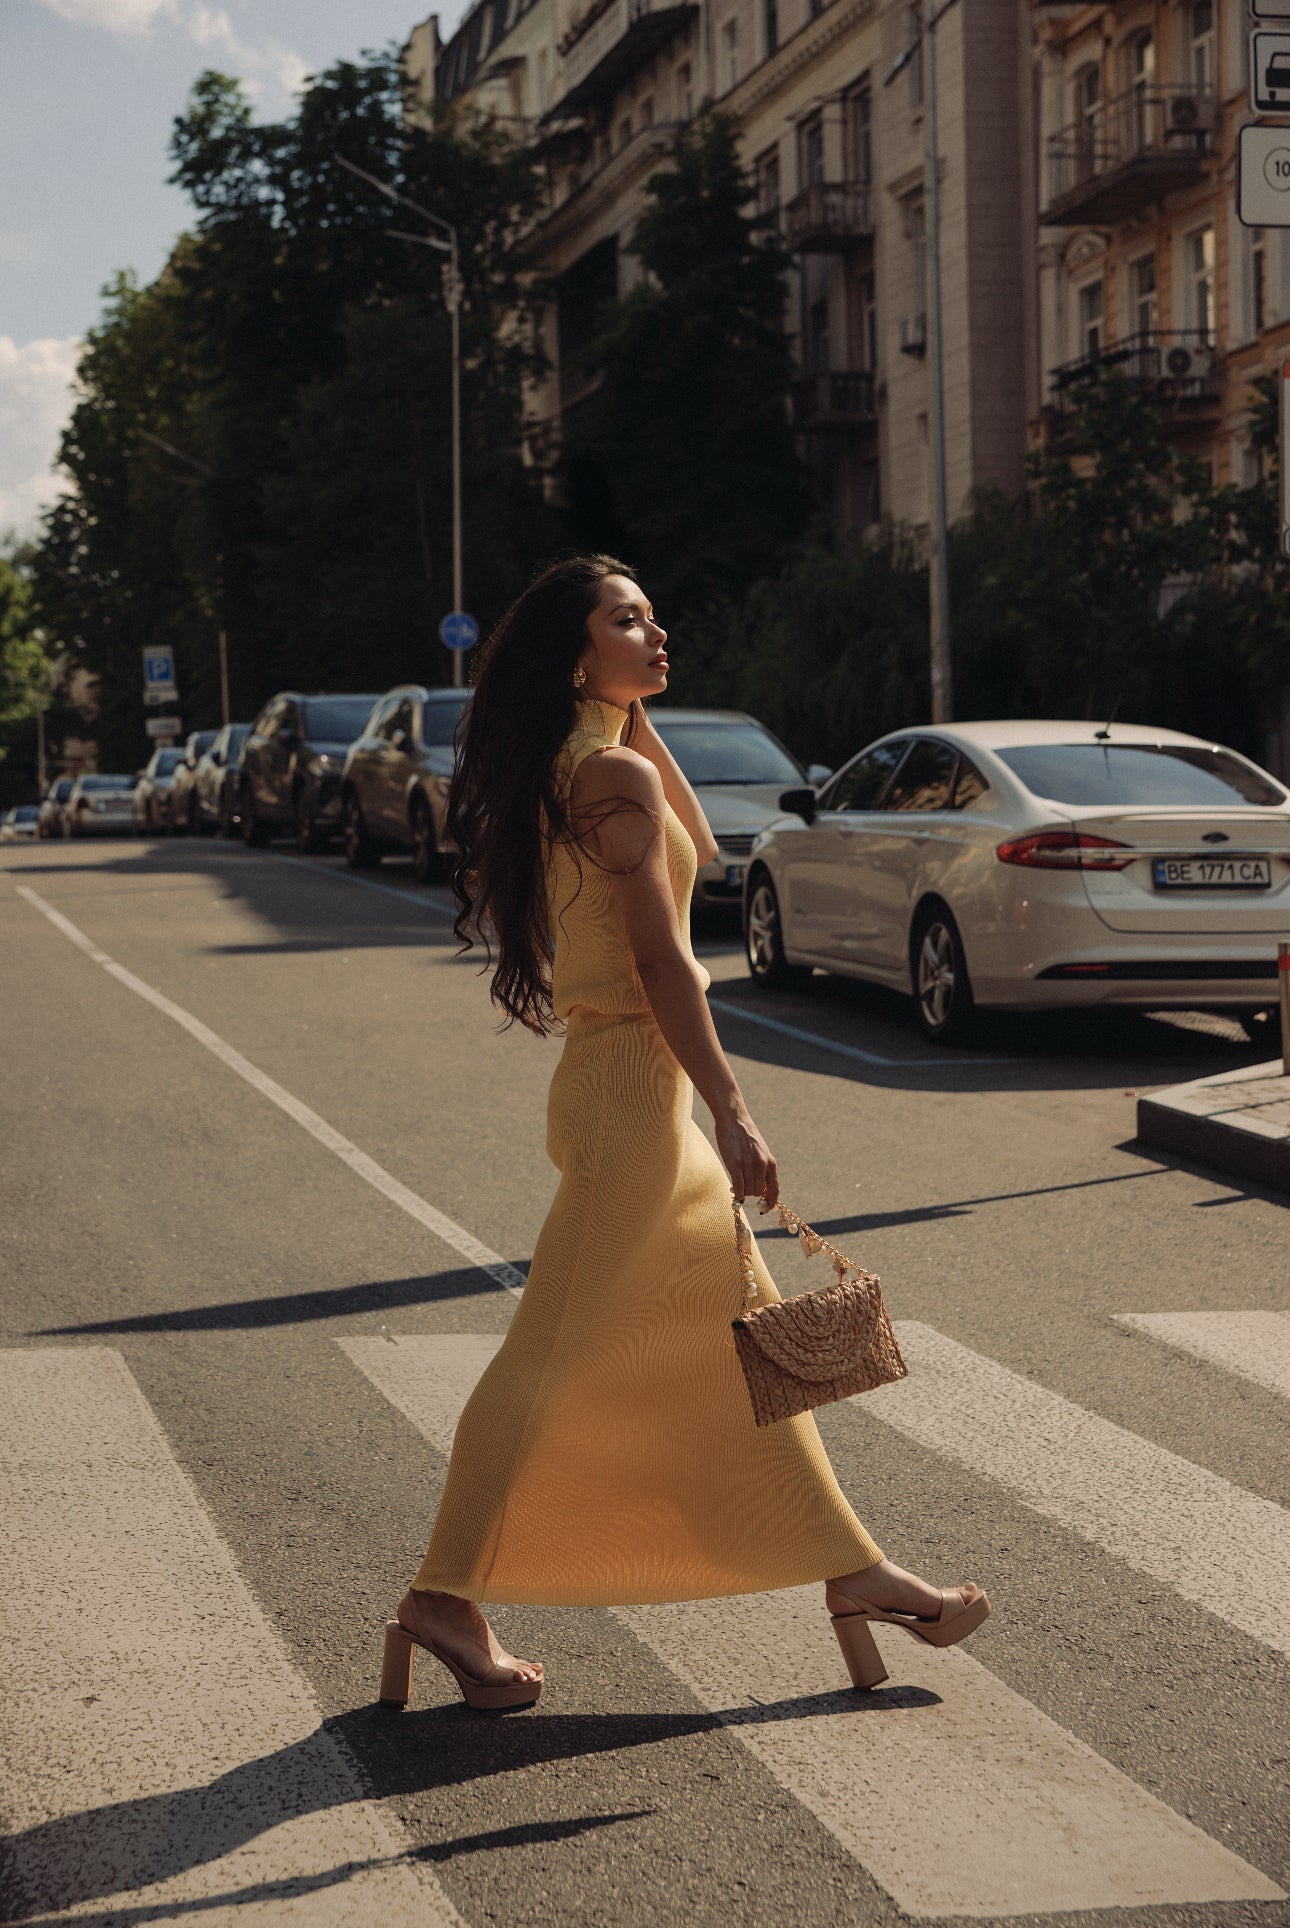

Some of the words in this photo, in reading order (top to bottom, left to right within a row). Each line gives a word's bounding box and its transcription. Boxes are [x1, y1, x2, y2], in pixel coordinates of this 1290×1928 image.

[1275, 161, 1290, 177] 10
[153, 659, 168, 680] P
[1167, 863, 1192, 881] BE
[1197, 863, 1235, 880] 1771
[1240, 863, 1264, 880] CA
